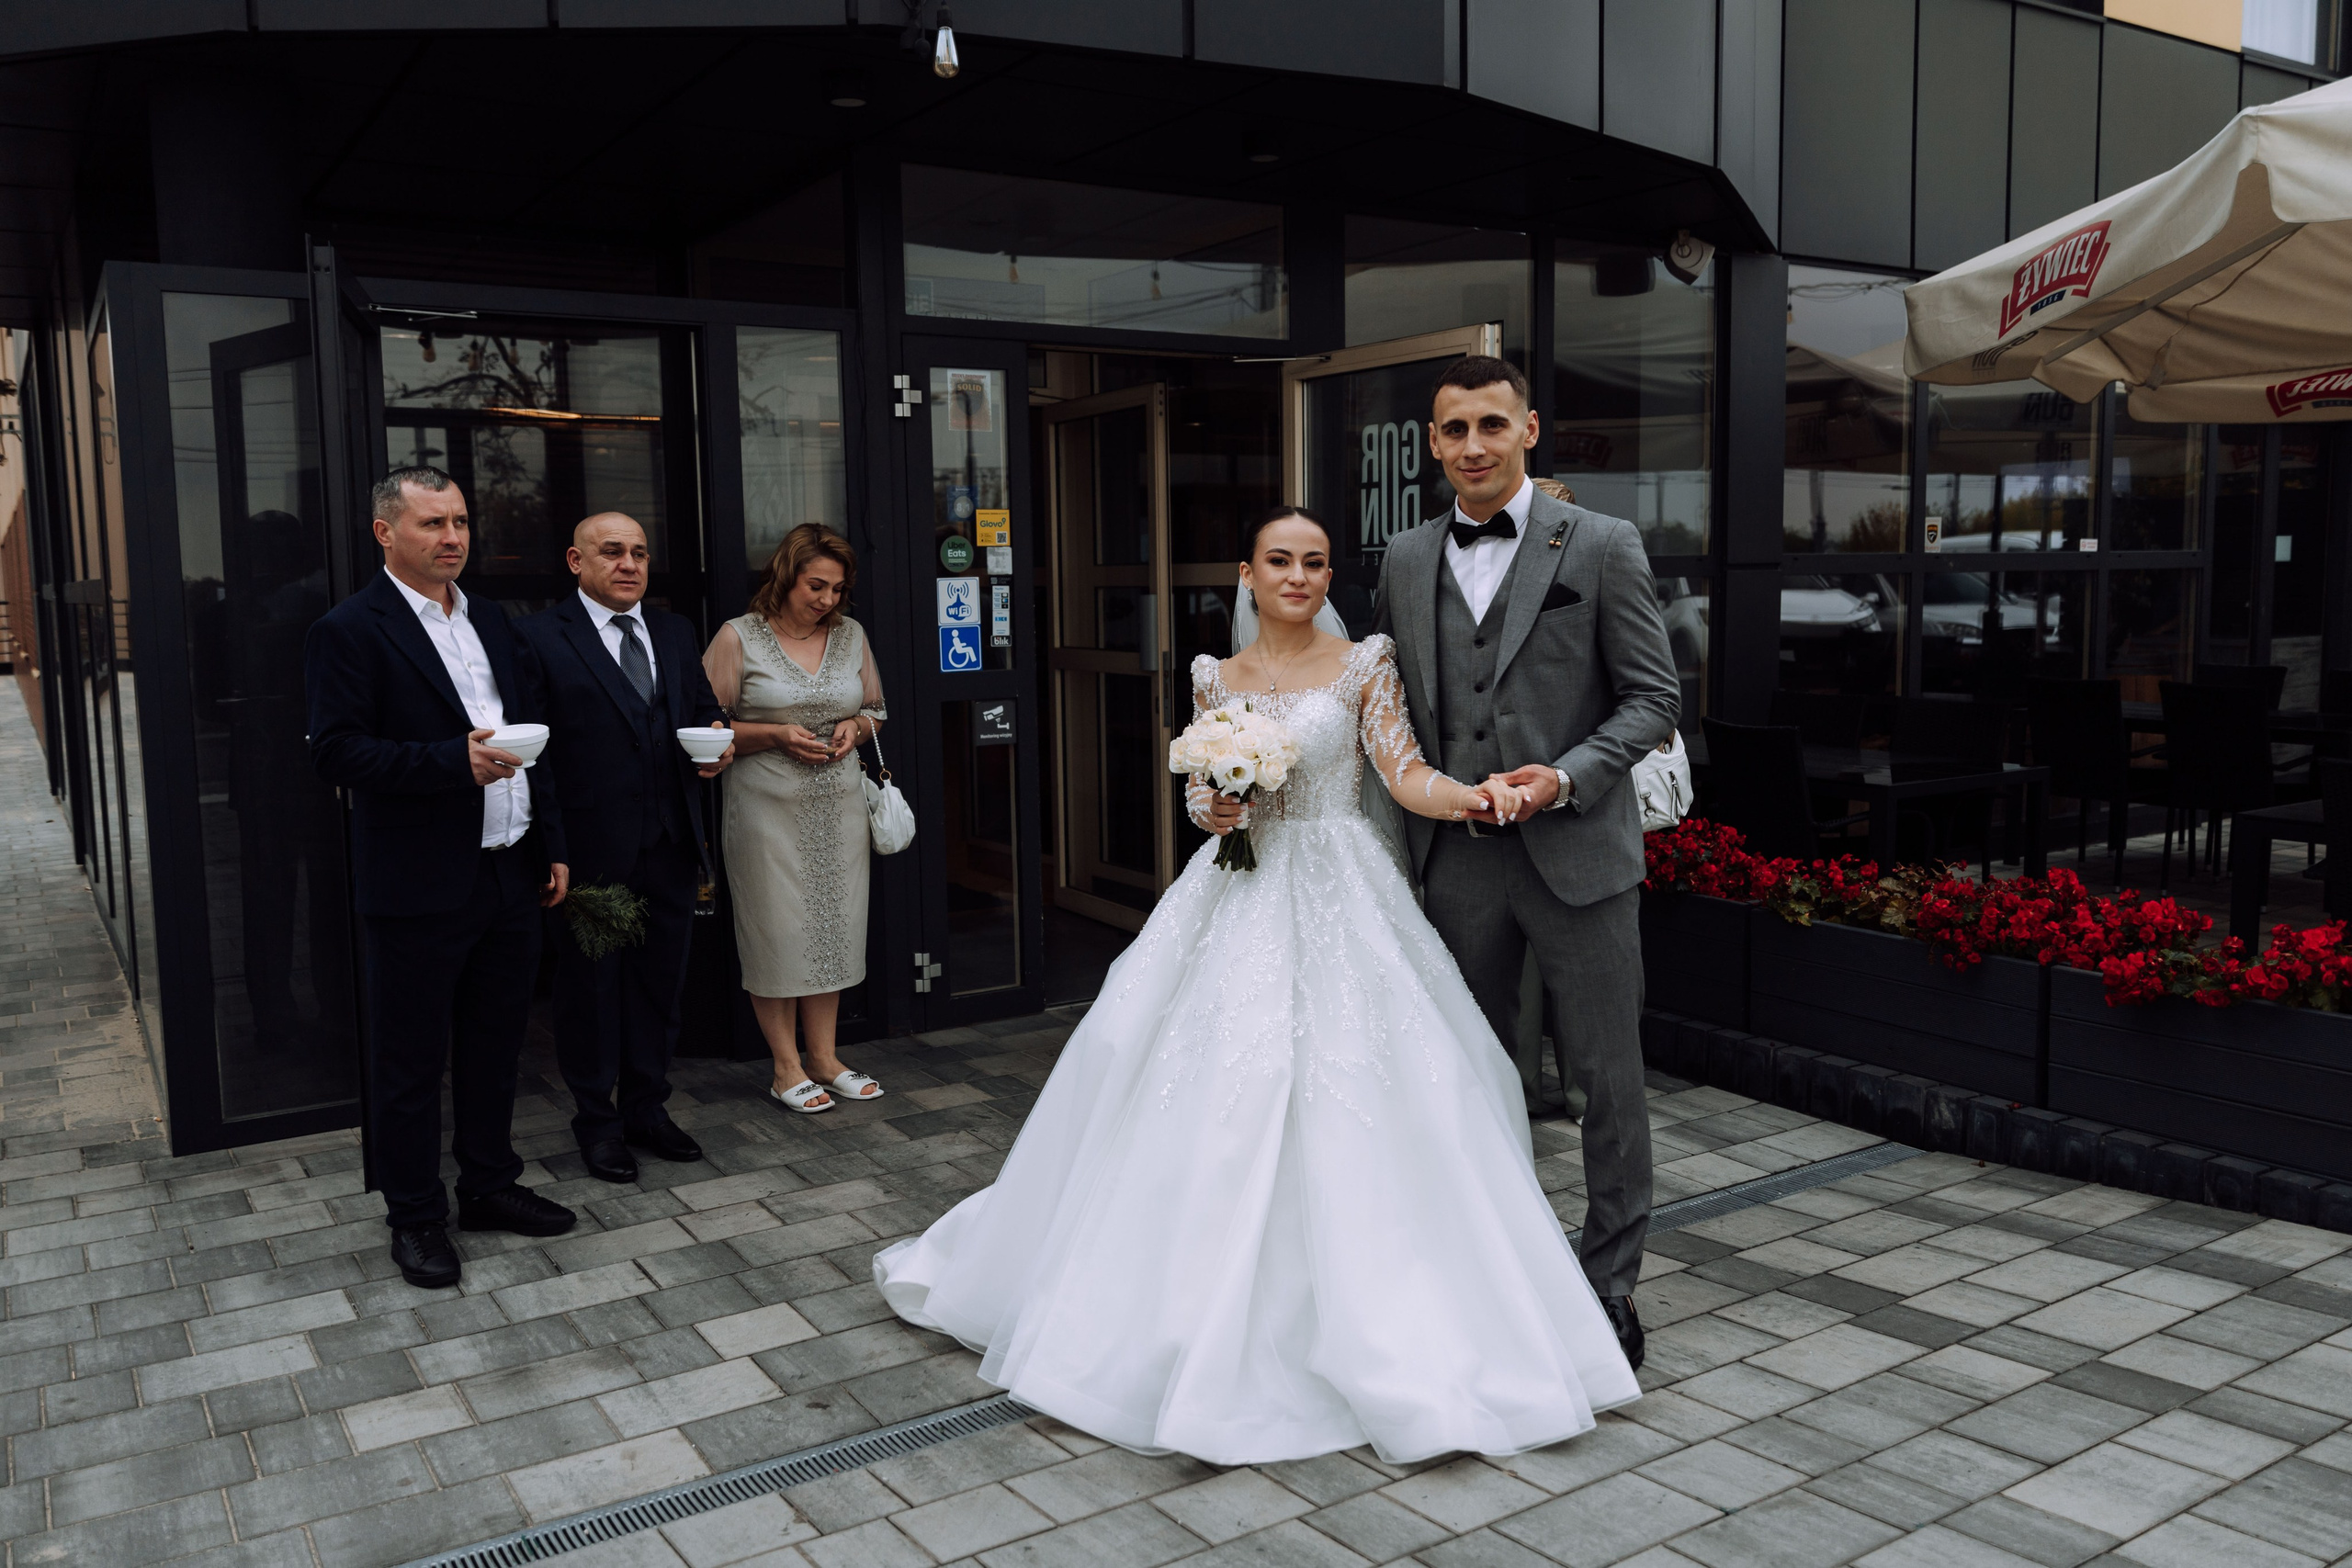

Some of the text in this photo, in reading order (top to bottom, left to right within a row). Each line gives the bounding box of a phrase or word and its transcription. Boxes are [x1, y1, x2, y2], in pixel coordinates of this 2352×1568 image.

[2017, 231, 2102, 308] ŻYWIEC
[2038, 293, 2060, 310] 1856
[956, 383, 982, 392] SOLID
[979, 520, 1003, 528] Glovo
[947, 541, 966, 549] Uber
[947, 549, 967, 558] Eats
[994, 637, 1009, 645] blik
